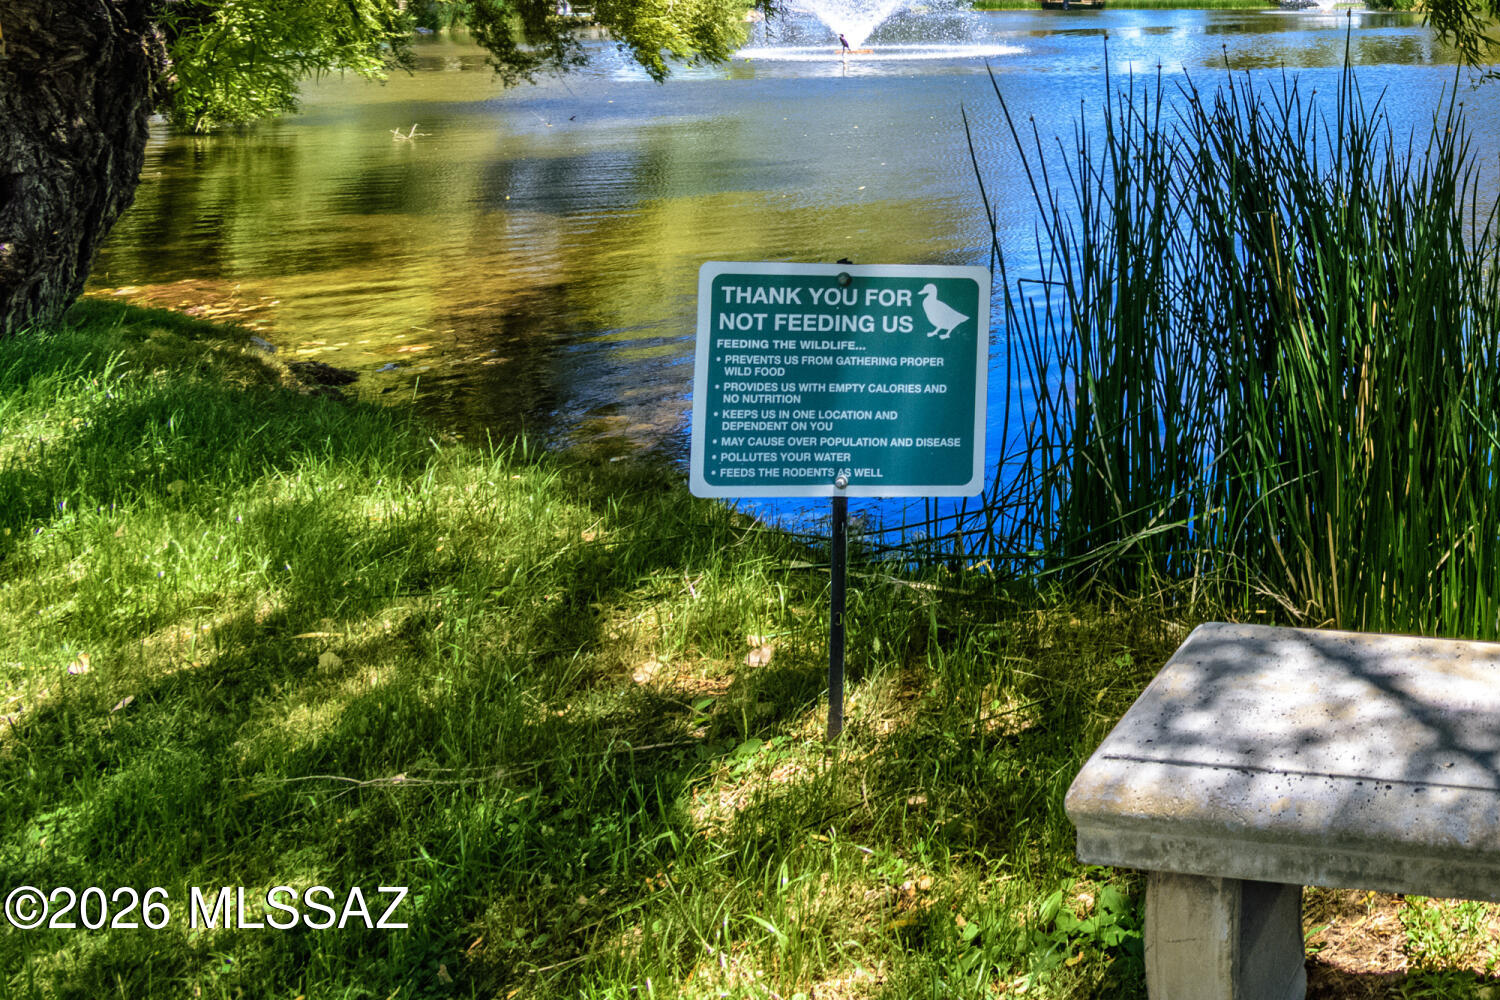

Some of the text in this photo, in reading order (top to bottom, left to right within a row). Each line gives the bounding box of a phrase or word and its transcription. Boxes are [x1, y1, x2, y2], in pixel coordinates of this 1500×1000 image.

[722, 286, 912, 306] THANK YOU FOR
[719, 313, 914, 333] NOT FEEDING US
[717, 340, 769, 349] FEEDING
[773, 340, 796, 349] THE
[725, 356, 944, 366] PREVENTS US FROM GATHERING PROPER
[724, 367, 785, 376] WILD FOOD
[724, 383, 947, 393] PROVIDES US WITH EMPTY CALORIES AND
[723, 394, 801, 404] NO NUTRITION
[722, 410, 897, 420] KEEPS US IN ONE LOCATION AND
[722, 422, 833, 431] DEPENDENT ON YOU
[721, 437, 960, 447] MAY CAUSE OVER POPULATION AND DISEASE
[720, 452, 851, 462] POLLUTES YOUR WATER
[720, 468, 883, 478] FEEDS THE RODENTS AS WELL
